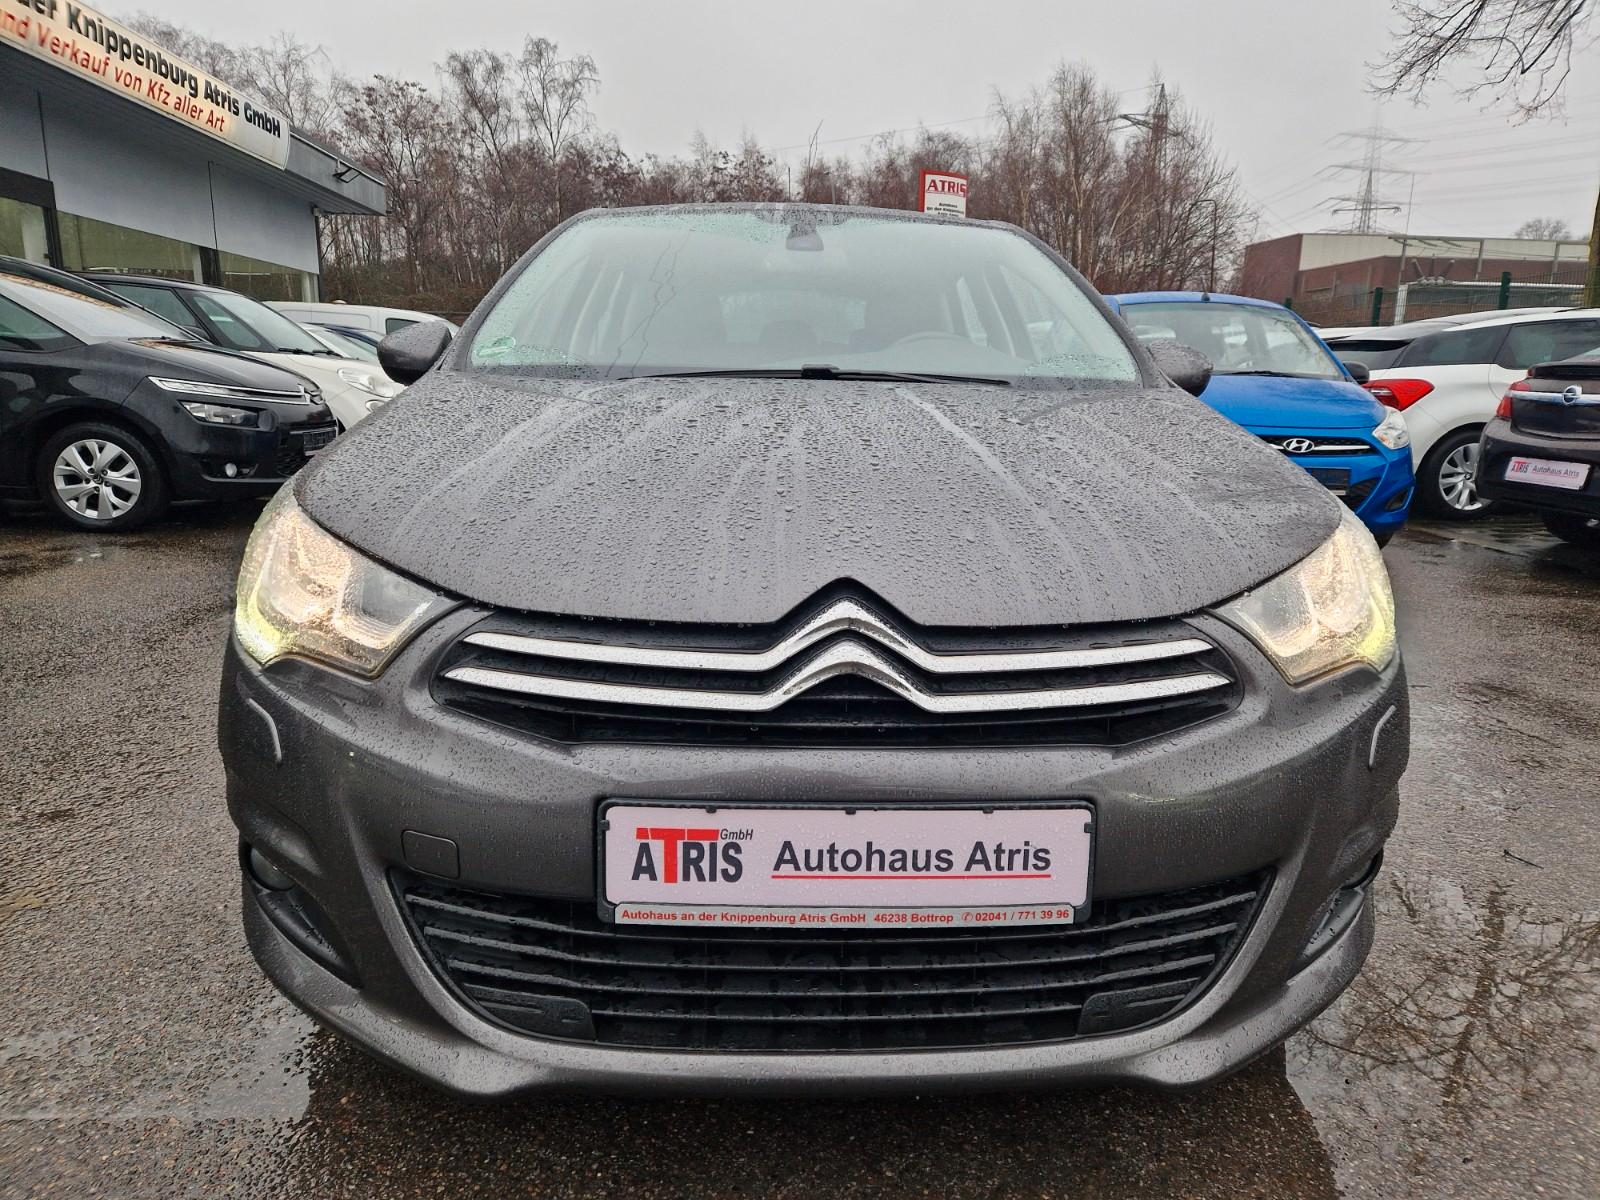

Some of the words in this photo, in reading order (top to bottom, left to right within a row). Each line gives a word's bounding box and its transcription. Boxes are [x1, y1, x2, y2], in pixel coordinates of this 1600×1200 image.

[17, 0, 57, 20] er
[65, 2, 199, 98] Knippenburg
[203, 79, 240, 116] Atris
[243, 101, 282, 138] GmbH
[37, 21, 111, 77] Verkauf
[114, 66, 142, 93] von
[146, 78, 171, 106] Kfz
[173, 94, 204, 121] aller
[205, 109, 226, 132] Art
[927, 178, 967, 194] ATRIS
[631, 827, 743, 884] ATRIS
[719, 828, 754, 841] GmbH
[772, 840, 954, 873] Autohaus
[964, 841, 1052, 873] Atris
[622, 909, 678, 920] Autohaus
[681, 912, 695, 921] an
[698, 911, 717, 921] der
[720, 911, 797, 925] Knippenburg
[800, 912, 827, 923] Atris
[830, 912, 866, 923] GmbH
[874, 913, 908, 923] 46238
[911, 912, 954, 924] Bottrop
[975, 911, 1007, 922] 02041
[1018, 910, 1036, 920] 771
[1040, 909, 1053, 920] 39
[1056, 908, 1070, 919] 96
